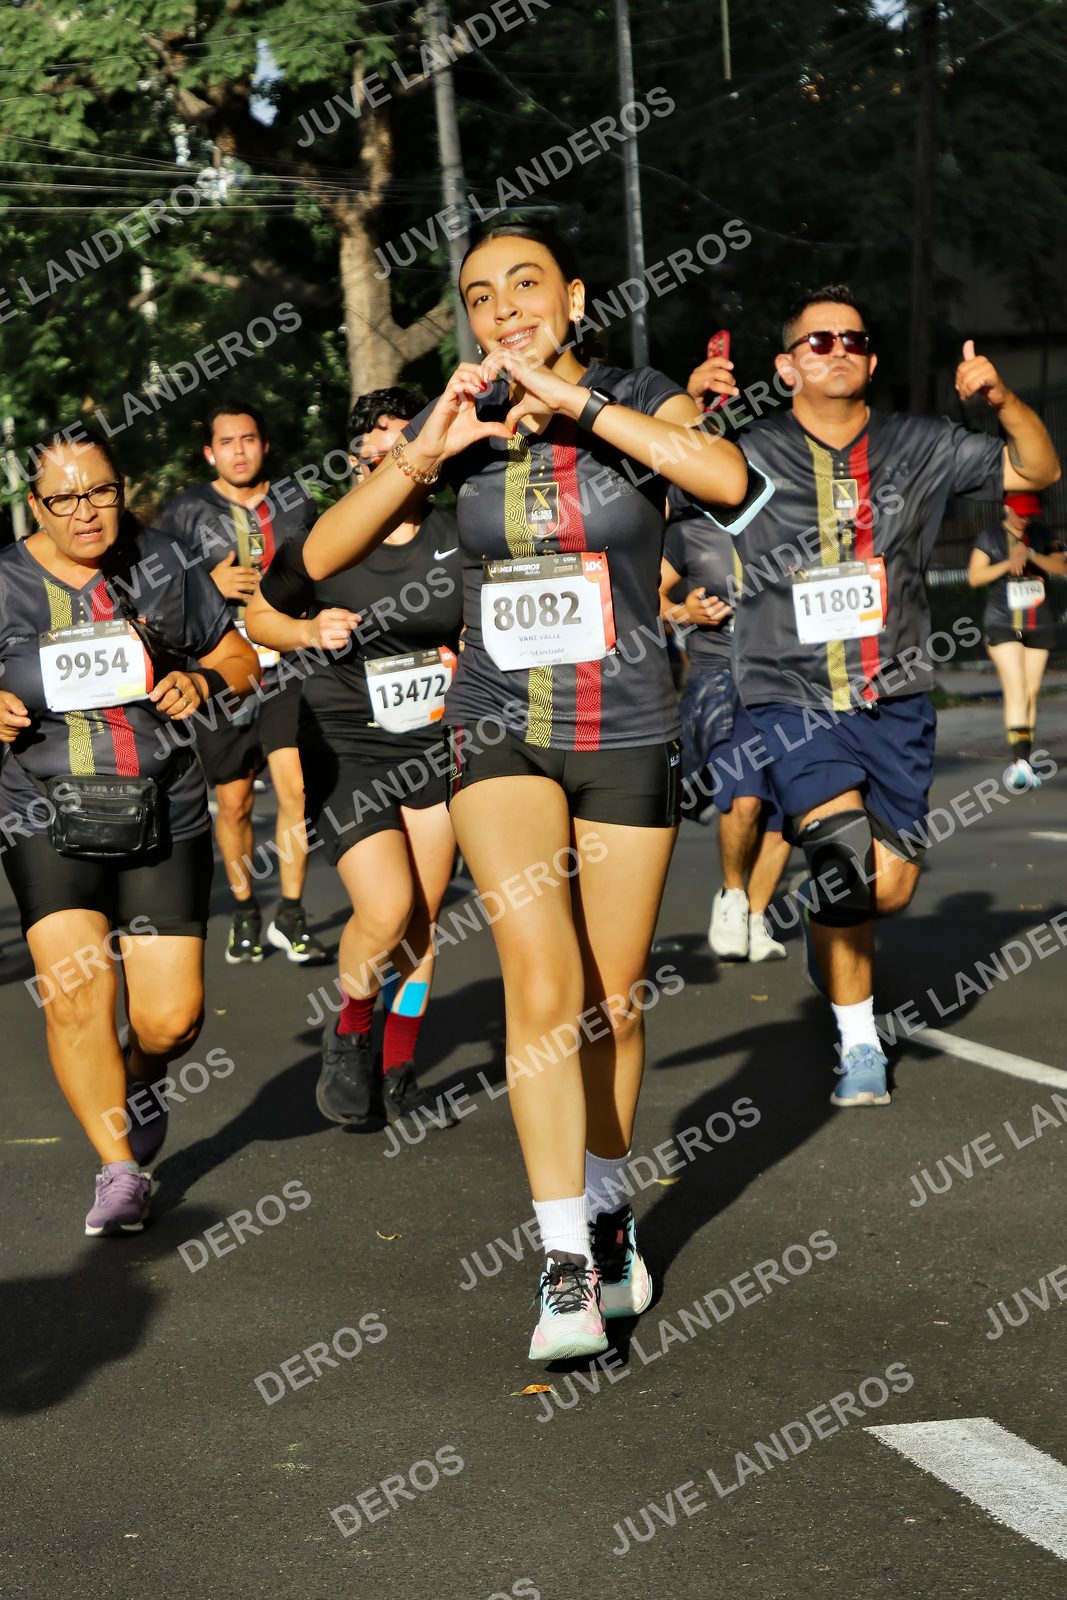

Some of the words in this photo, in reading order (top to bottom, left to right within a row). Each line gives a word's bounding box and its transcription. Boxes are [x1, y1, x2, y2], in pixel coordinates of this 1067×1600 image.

[493, 591, 582, 631] 8082
[800, 585, 875, 616] 11803
[55, 647, 129, 681] 9954
[376, 674, 446, 709] 13472
